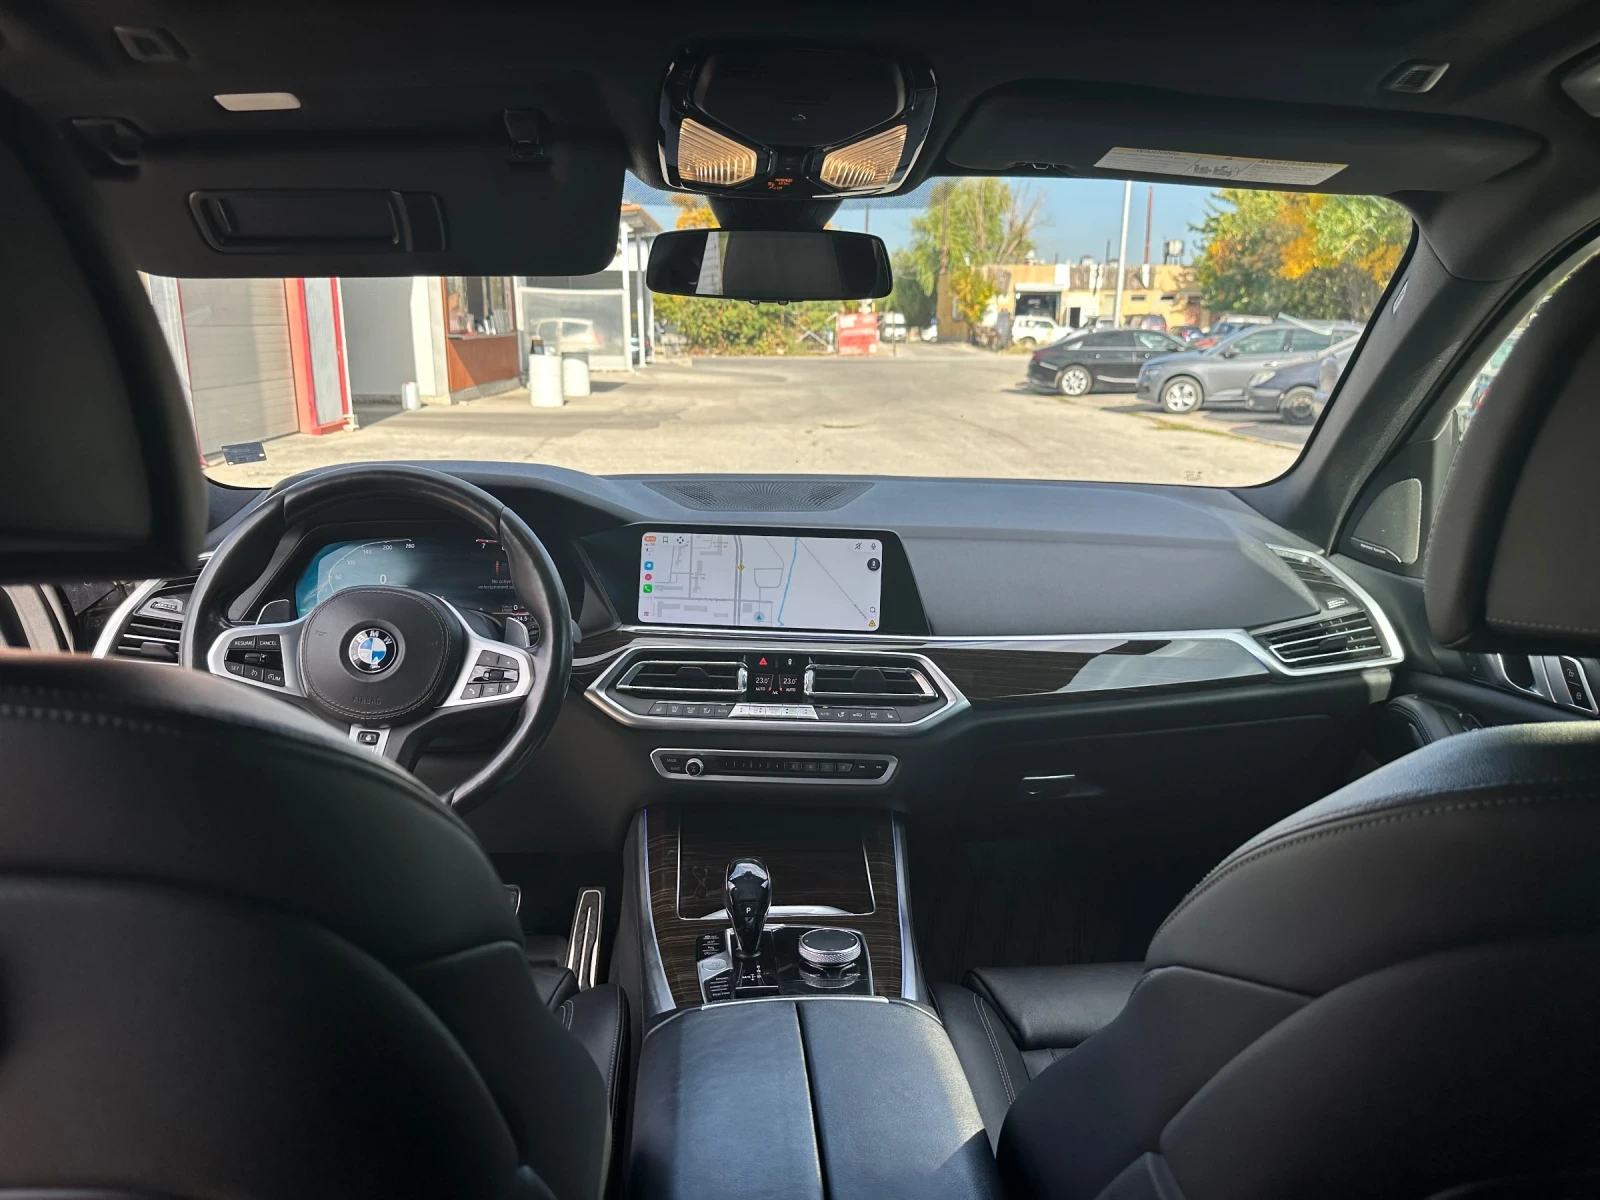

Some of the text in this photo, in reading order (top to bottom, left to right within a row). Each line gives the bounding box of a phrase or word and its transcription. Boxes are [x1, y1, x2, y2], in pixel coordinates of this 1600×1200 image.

[379, 573, 387, 585] 0
[356, 630, 393, 645] BMW
[352, 695, 382, 705] AIRBAG
[746, 906, 752, 914] P
